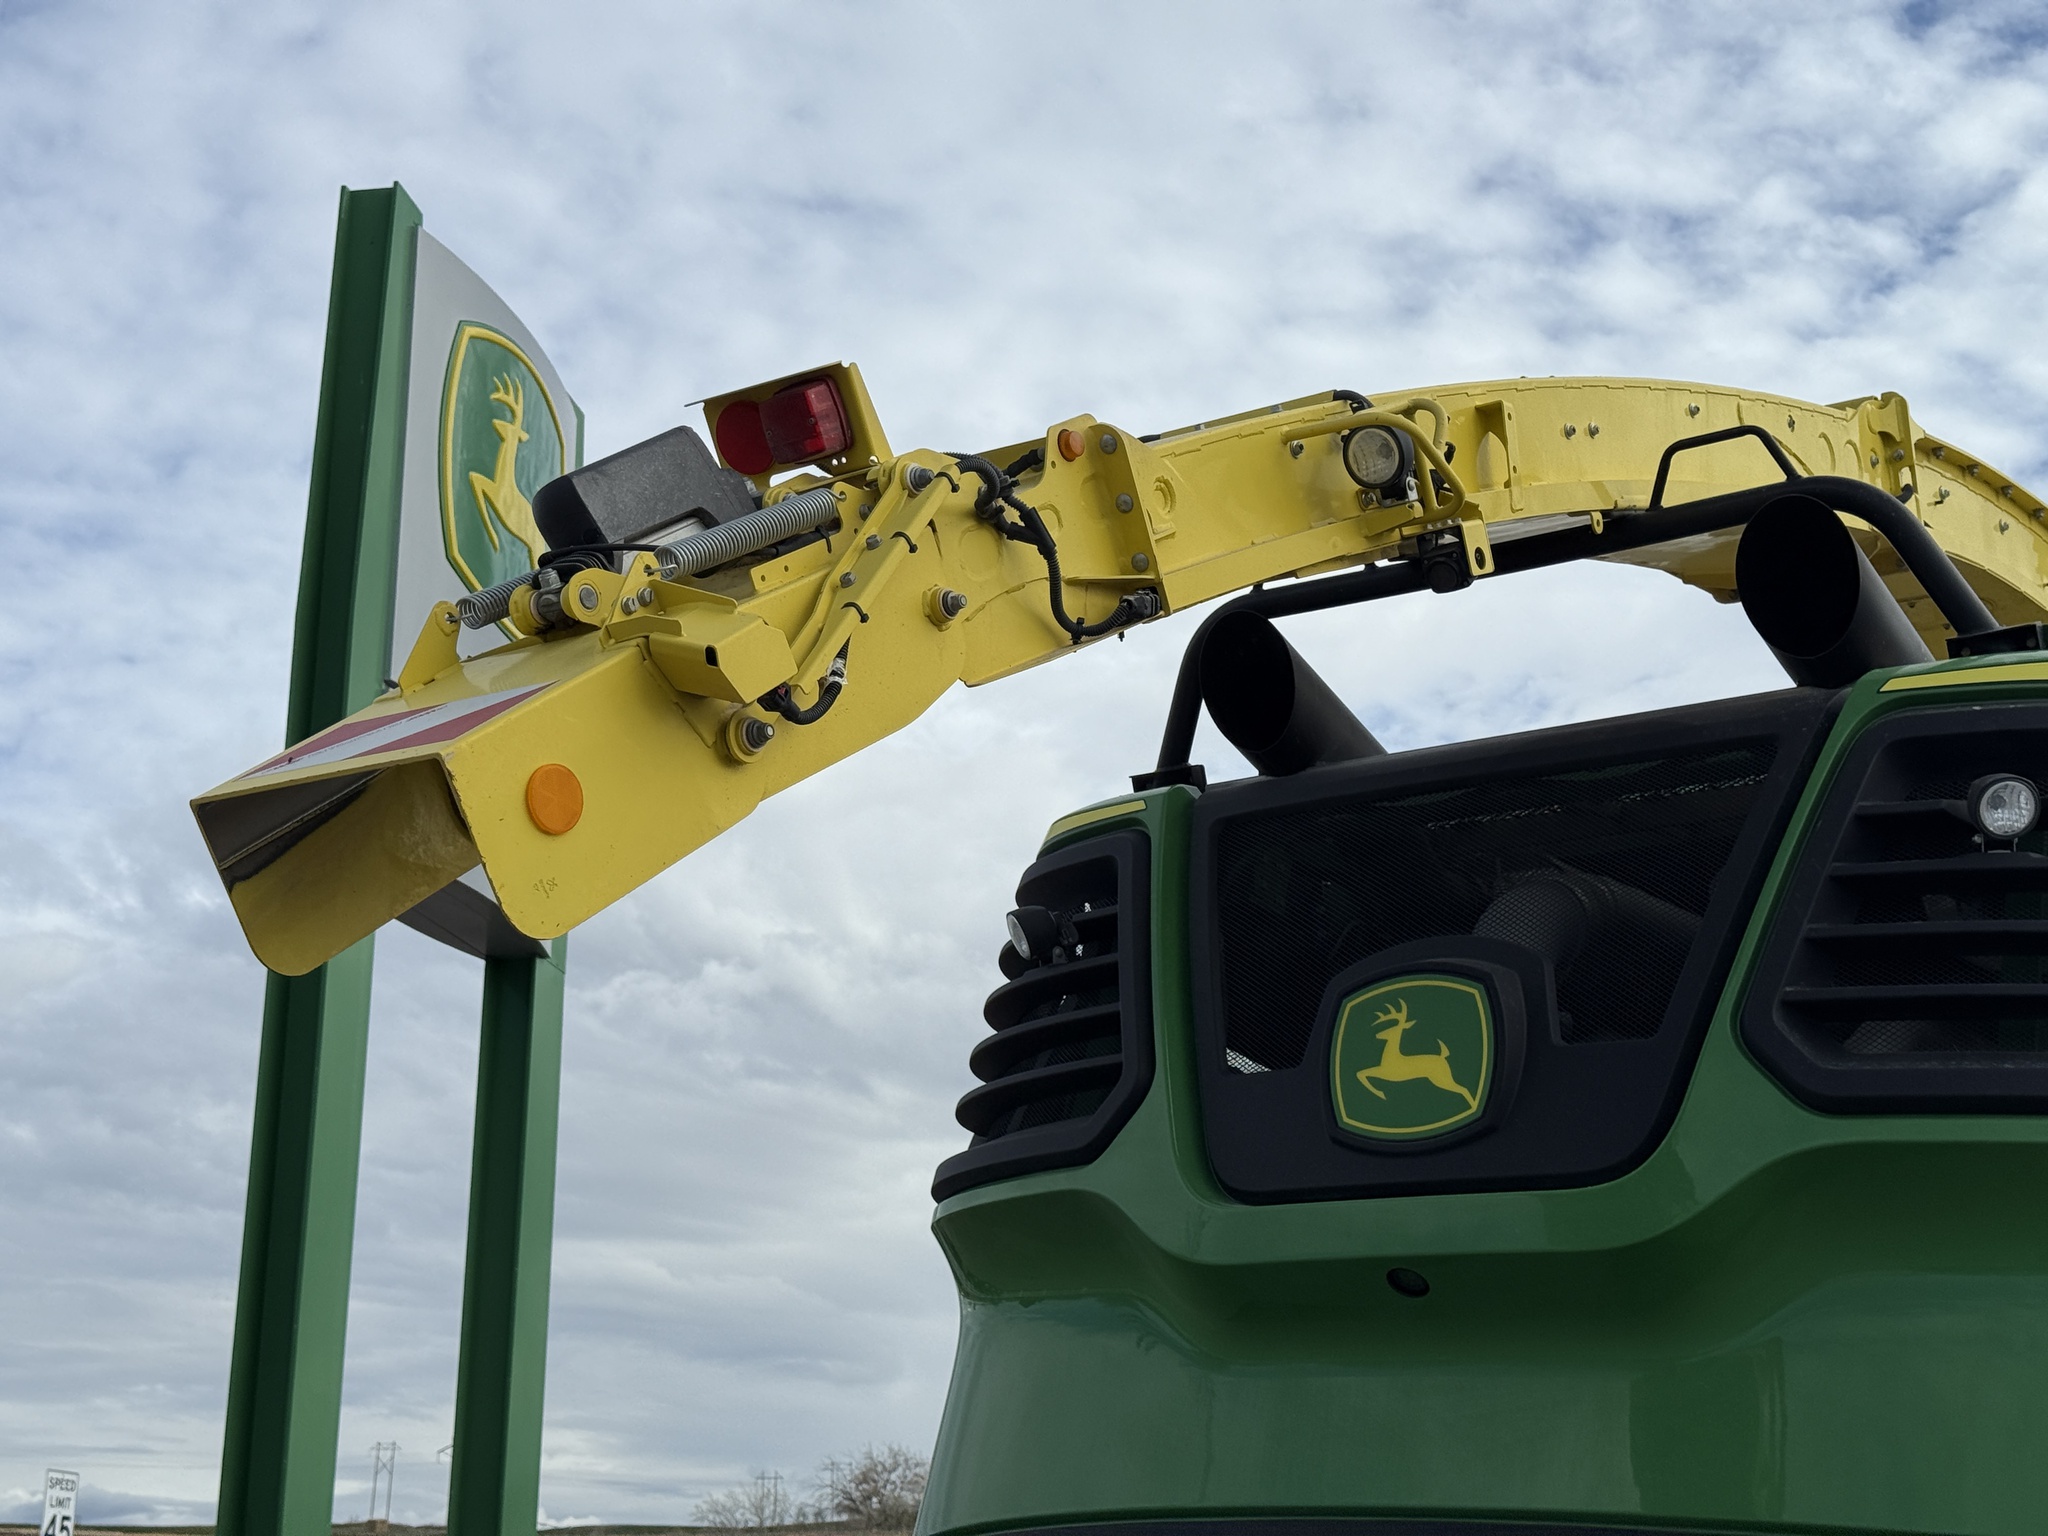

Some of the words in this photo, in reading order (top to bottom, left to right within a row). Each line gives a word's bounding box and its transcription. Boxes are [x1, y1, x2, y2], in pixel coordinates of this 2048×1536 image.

[49, 1476, 77, 1492] SPEED
[49, 1495, 72, 1510] LIMIT
[44, 1514, 71, 1536] 45
